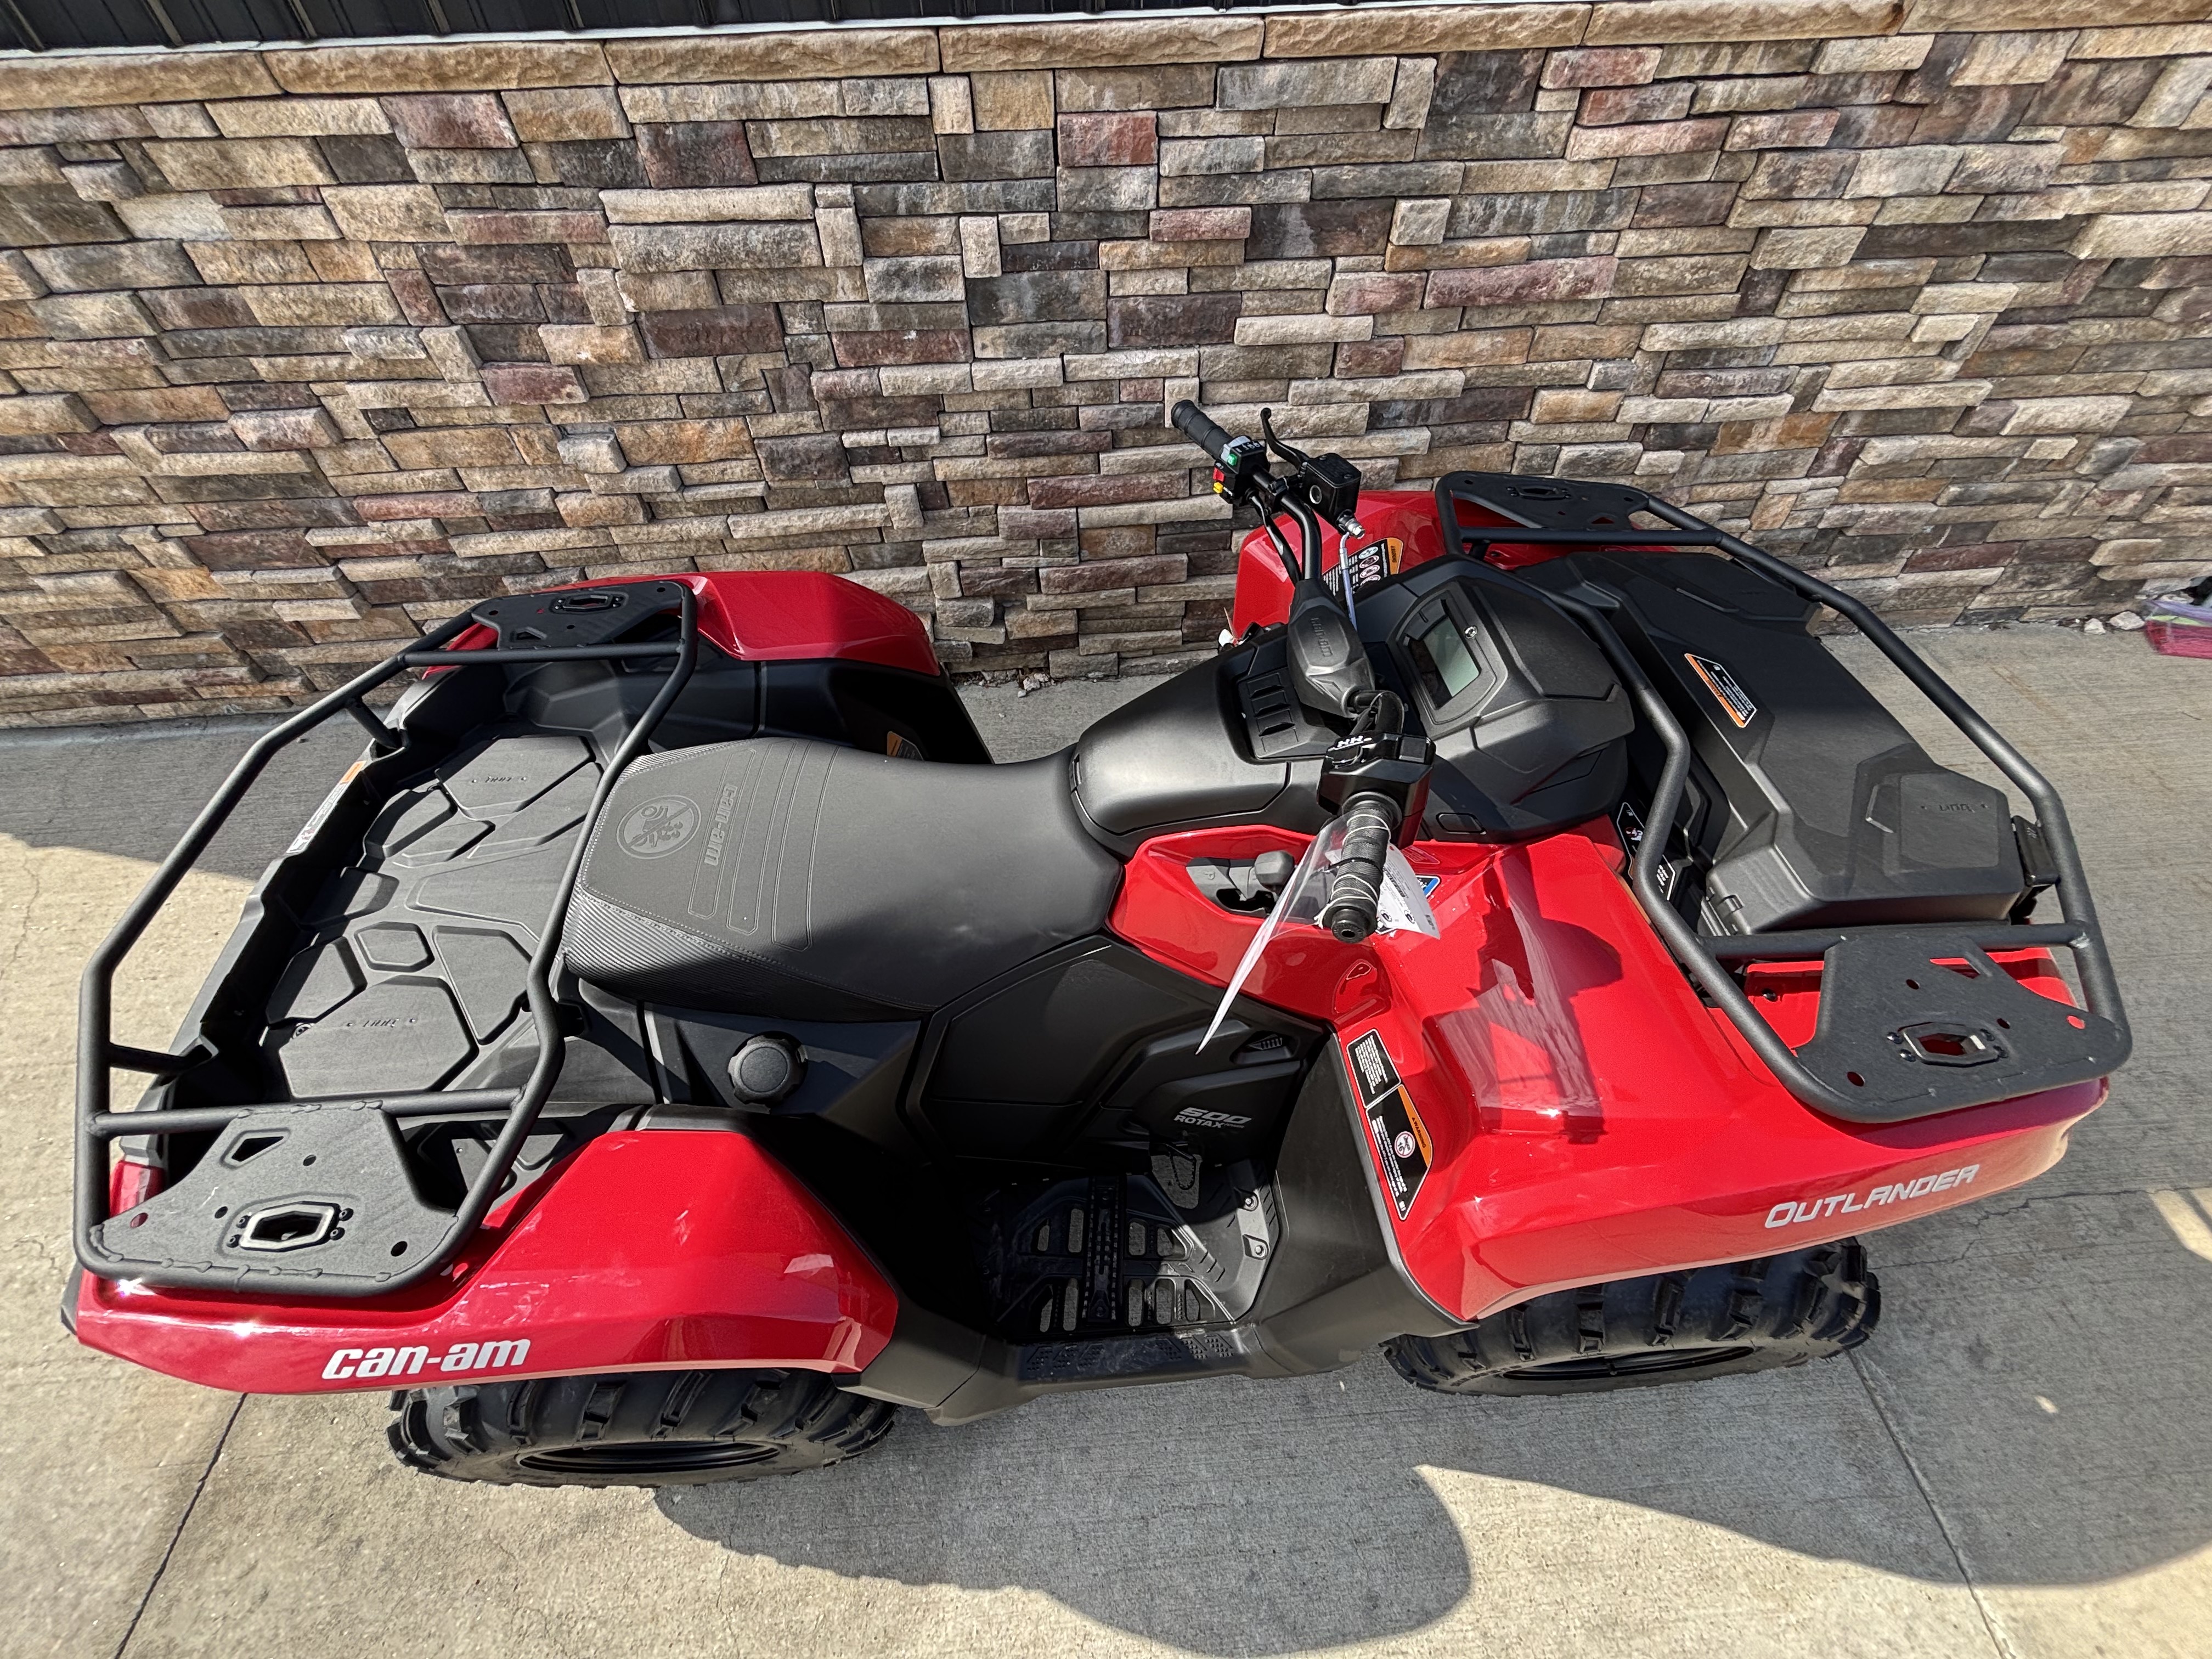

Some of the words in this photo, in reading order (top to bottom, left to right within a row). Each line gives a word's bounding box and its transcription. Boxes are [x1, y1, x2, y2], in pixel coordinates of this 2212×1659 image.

[704, 785, 738, 866] can-am
[1173, 1115, 1225, 1128] ROTAX
[1180, 1107, 1252, 1124] 500
[1414, 1120, 1426, 1148] WARNING
[1764, 1164, 1979, 1229] OUTLANDER
[321, 1339, 531, 1380] can-am
